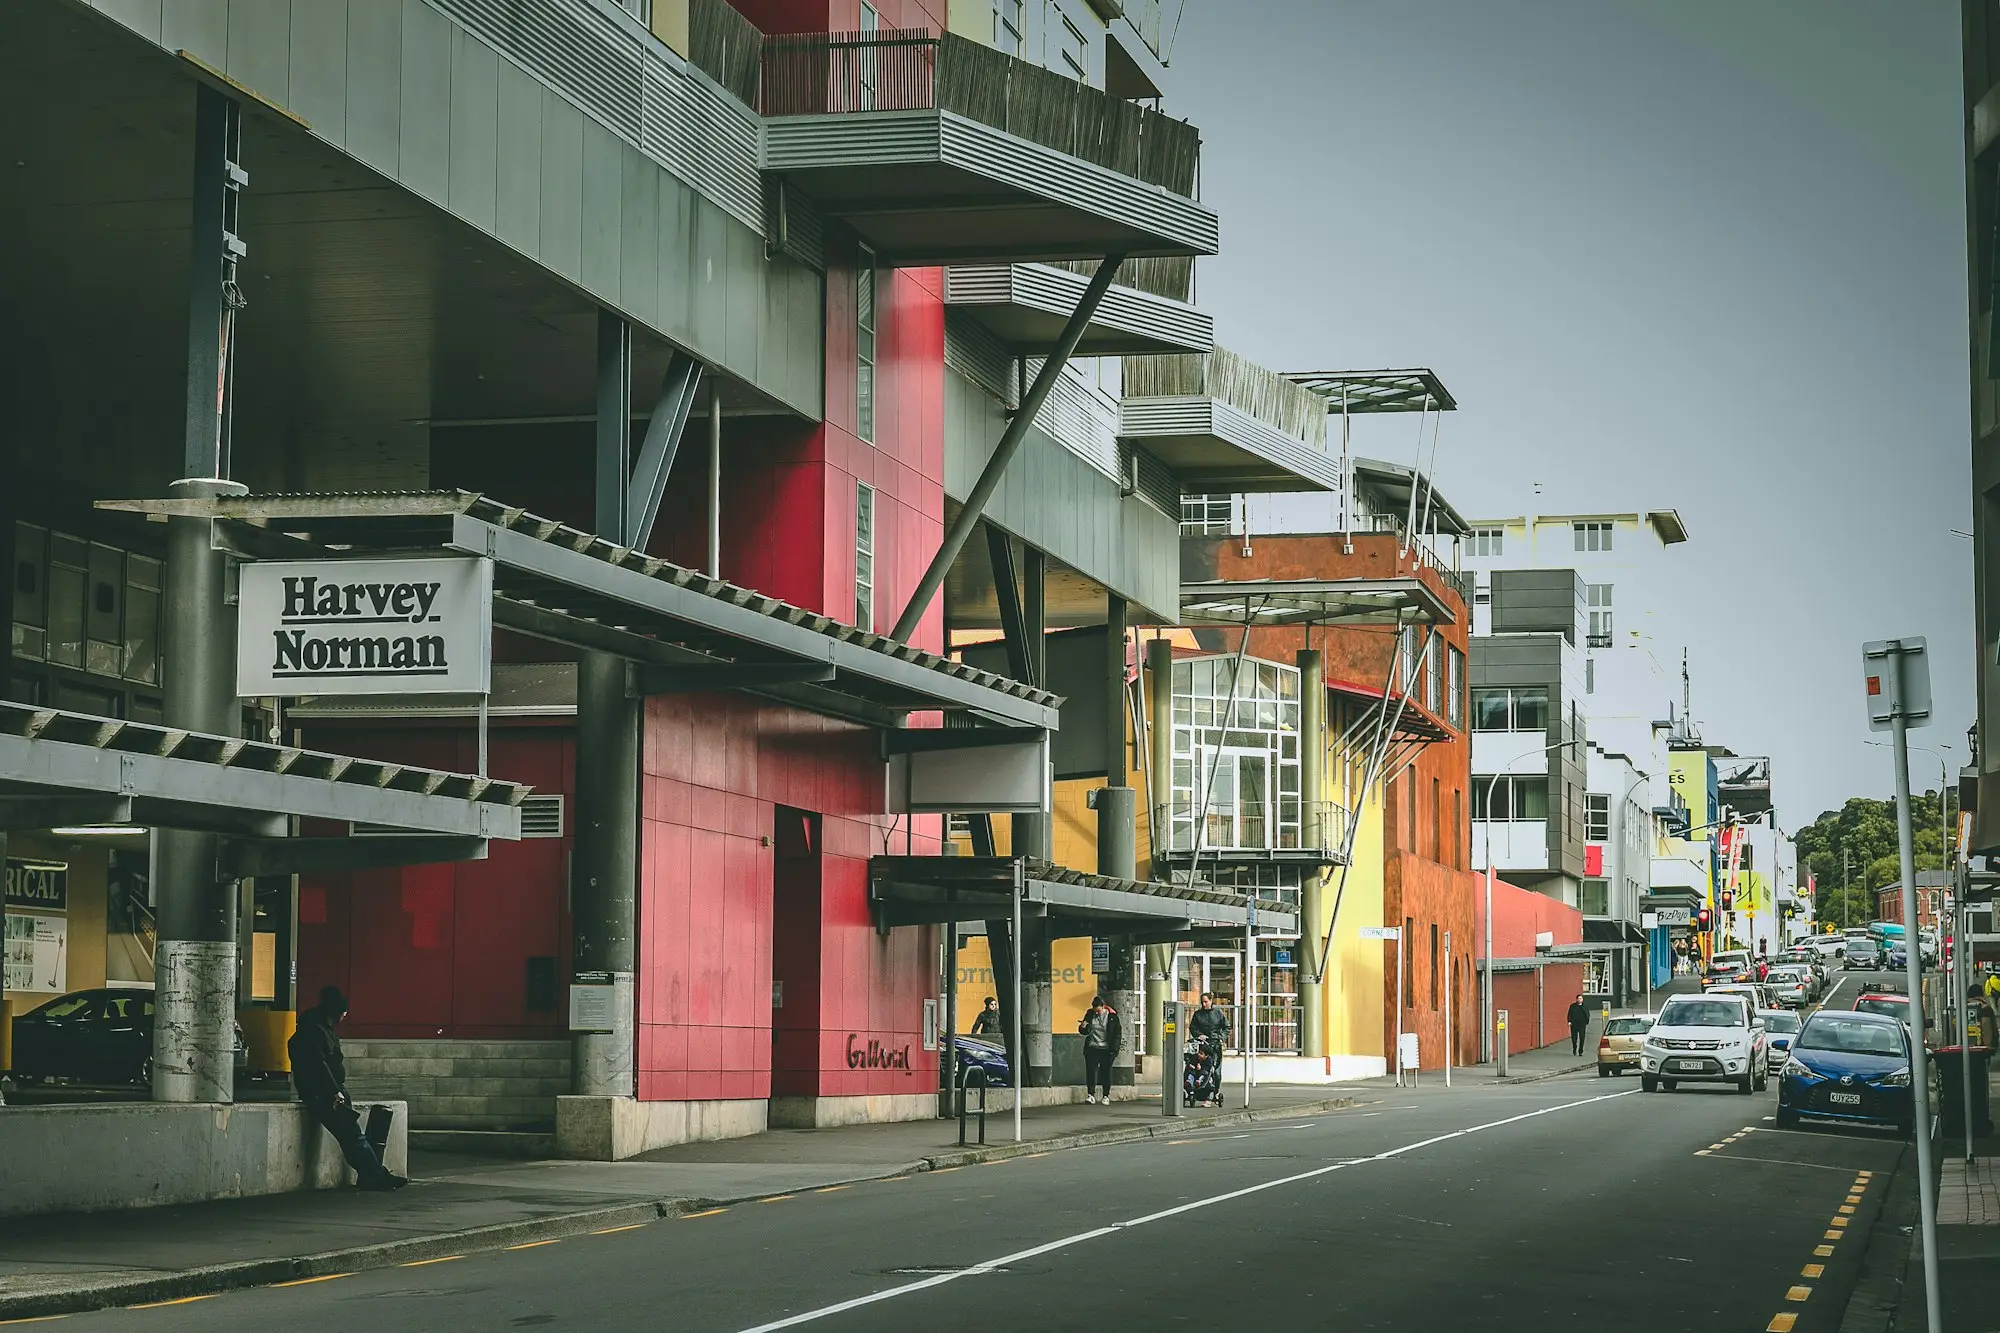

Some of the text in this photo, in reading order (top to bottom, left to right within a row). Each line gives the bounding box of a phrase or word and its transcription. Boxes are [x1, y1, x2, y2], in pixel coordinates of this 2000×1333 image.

[281, 576, 441, 624] Harvey
[272, 629, 448, 671] Norman
[1167, 1008, 1175, 1018] P
